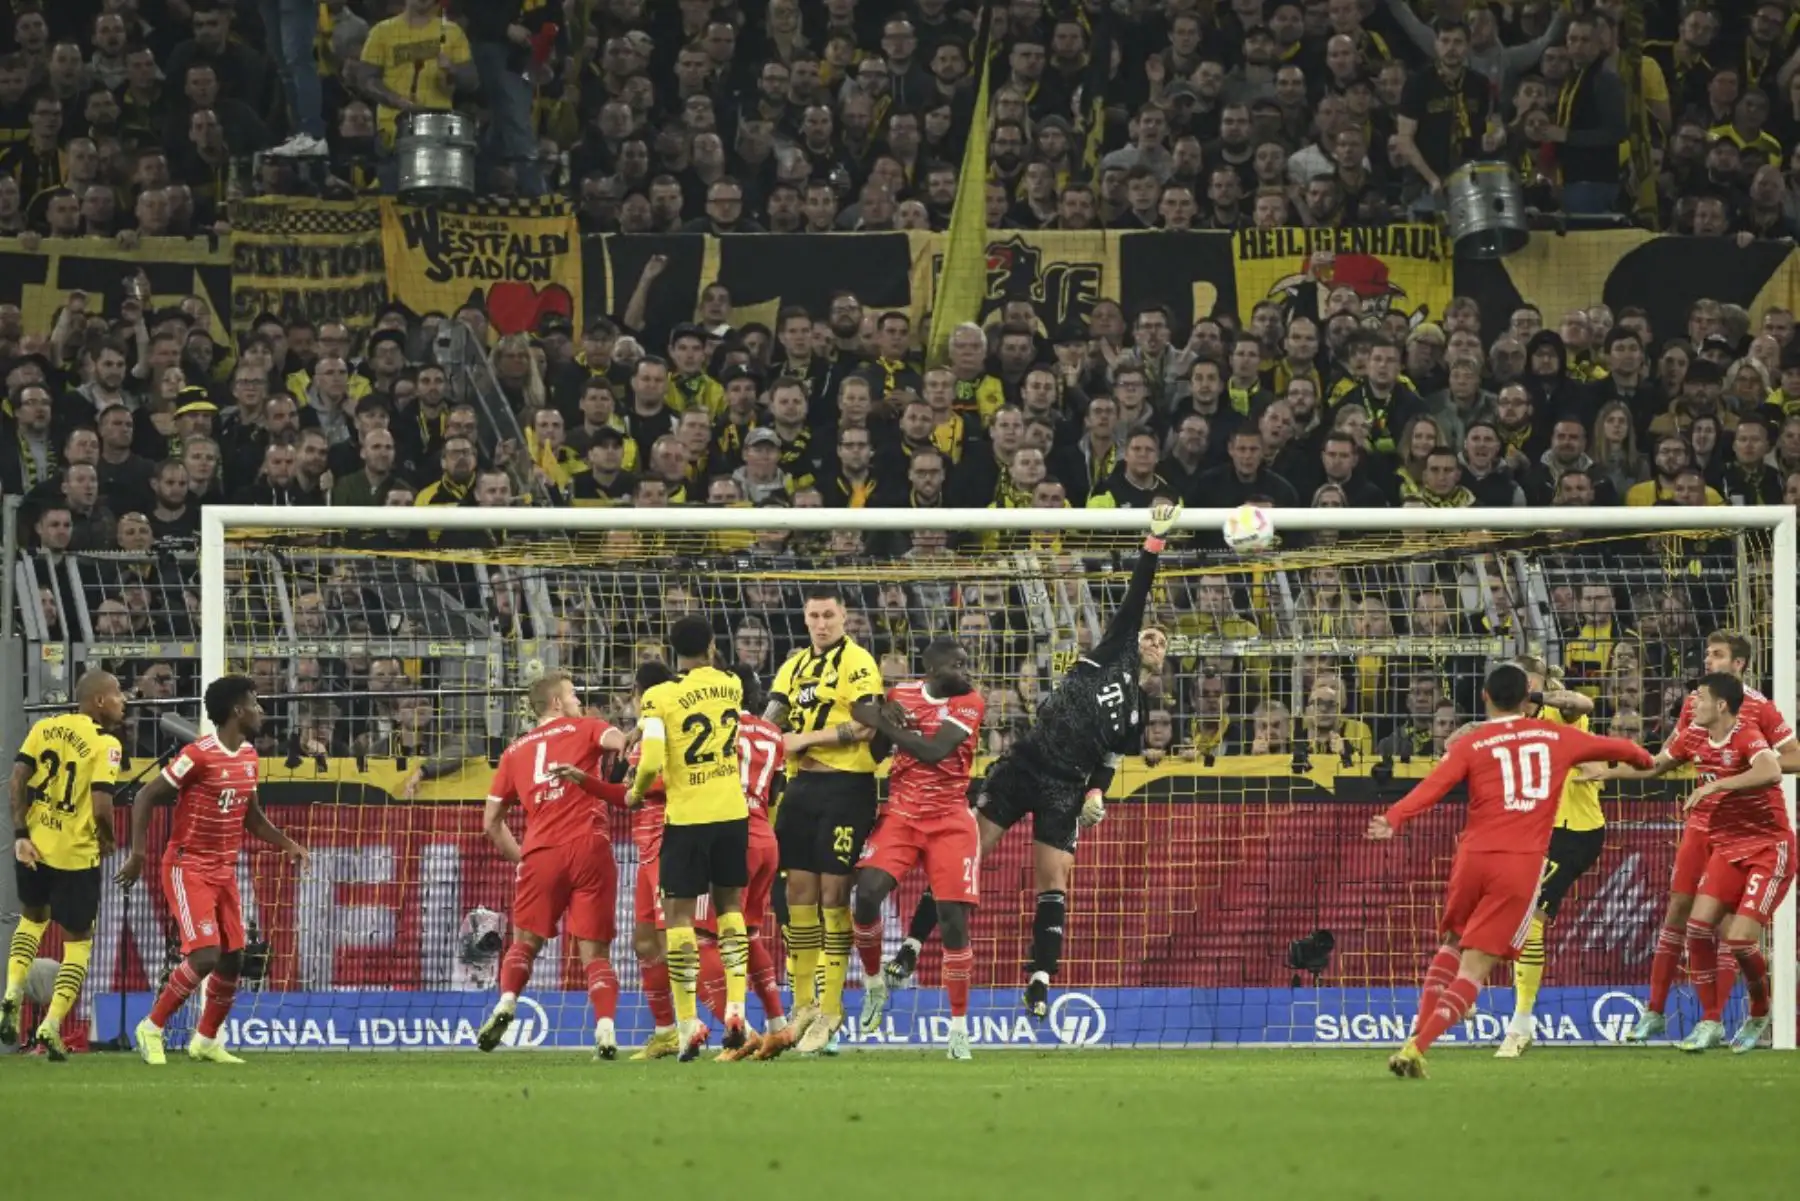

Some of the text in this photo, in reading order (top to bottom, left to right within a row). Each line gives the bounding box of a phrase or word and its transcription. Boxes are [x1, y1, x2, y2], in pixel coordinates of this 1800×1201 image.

[401, 205, 570, 258] WESTFALEN
[424, 252, 552, 283] STADION
[678, 685, 741, 710] DORTMUND
[42, 726, 92, 758] DORTMUND
[682, 708, 740, 767] 22
[30, 748, 77, 812] 21
[533, 741, 560, 788] 4
[739, 736, 776, 795] 17
[1491, 743, 1551, 806] 10
[833, 826, 855, 852] 25
[1746, 872, 1764, 896] 5
[359, 1018, 479, 1046] IDUNA
